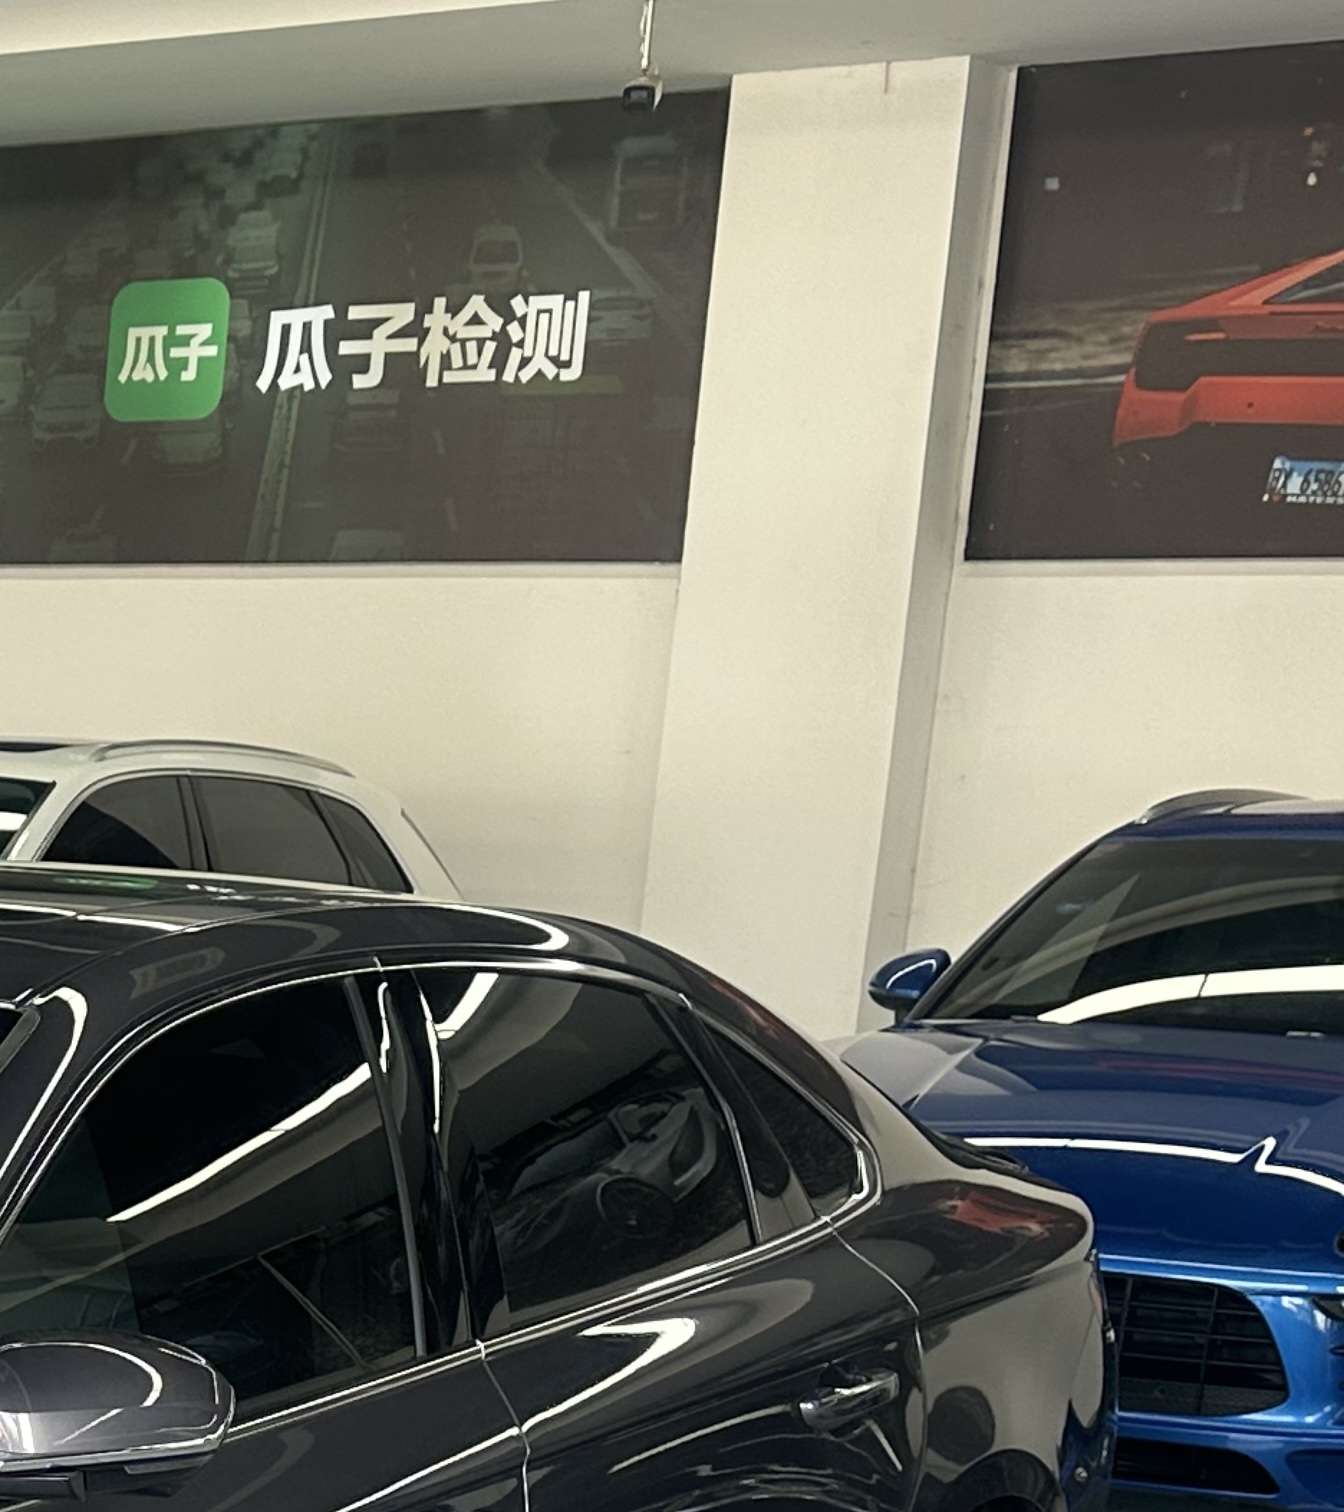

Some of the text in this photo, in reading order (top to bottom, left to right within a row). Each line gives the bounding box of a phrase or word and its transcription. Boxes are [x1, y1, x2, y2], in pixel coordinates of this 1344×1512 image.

[118, 323, 219, 384] 瓜子
[256, 290, 590, 395] 瓜子检测
